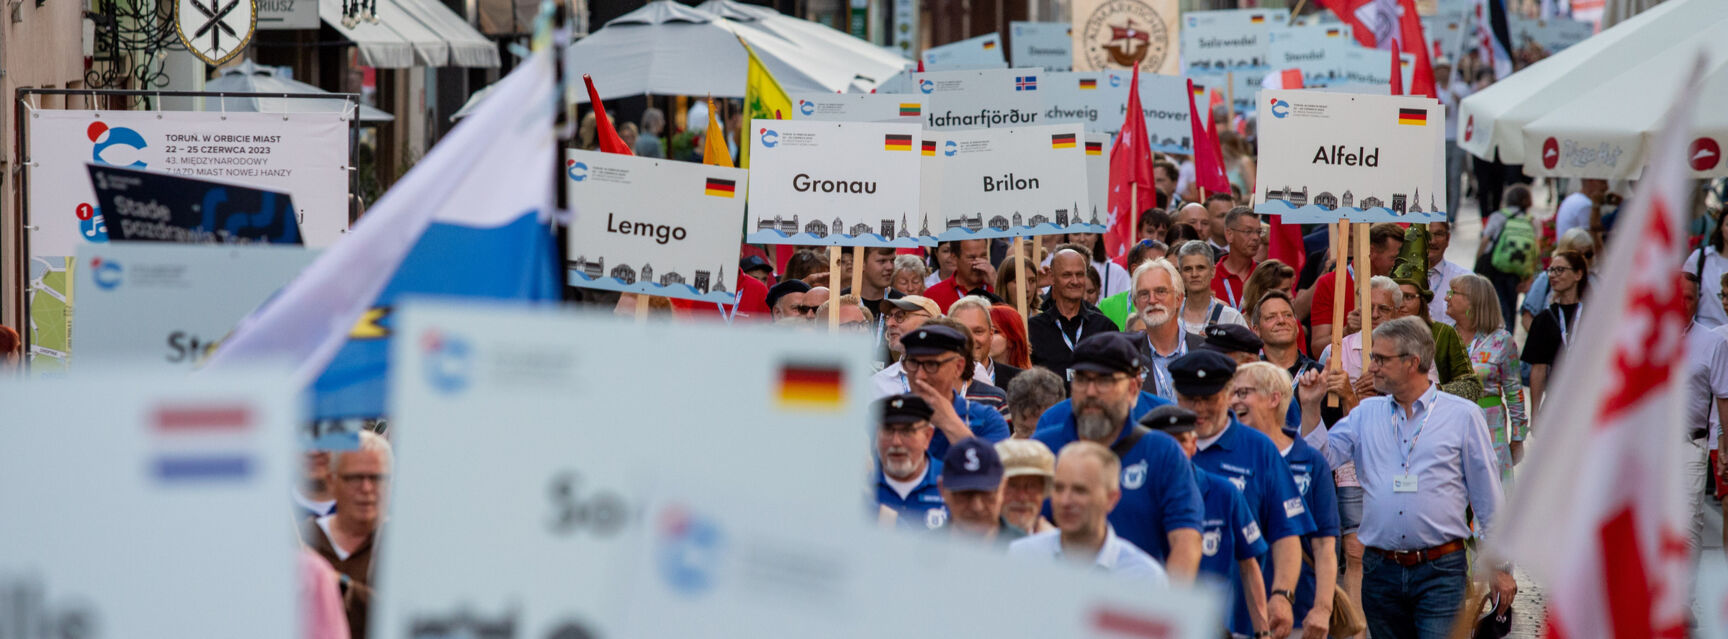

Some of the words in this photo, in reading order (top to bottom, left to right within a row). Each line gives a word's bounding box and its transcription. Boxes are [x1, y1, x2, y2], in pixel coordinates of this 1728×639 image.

[257, 0, 295, 12] RIUSZ
[929, 109, 1038, 128] Hafnarfjörður
[1045, 105, 1098, 121] chweig
[1120, 104, 1188, 121] Hnnover
[213, 135, 250, 143] ORBICIE
[253, 135, 281, 143] MIAST
[165, 145, 177, 153] 22
[187, 145, 199, 154] 25
[201, 146, 246, 154] CZERWCA
[248, 146, 271, 154] 2023
[1312, 145, 1379, 168] Alfeld
[181, 157, 268, 166] MIĘDZYNARODOWY
[196, 168, 223, 176] MIAST
[226, 168, 258, 176] NOWEJ
[261, 169, 292, 177] HANZY
[792, 173, 877, 194] Gronau
[983, 173, 1040, 192] Brilon
[607, 213, 687, 245] Lemgo
[546, 469, 645, 540] So
